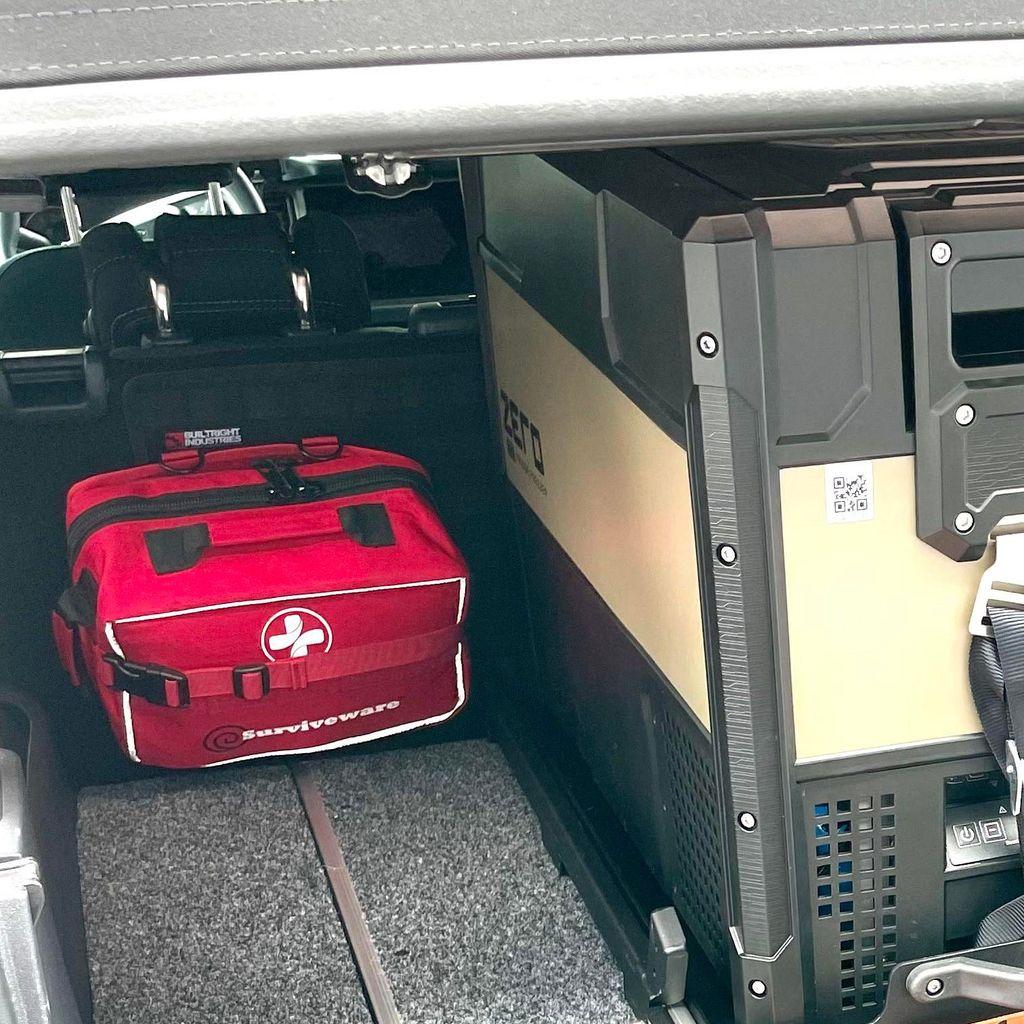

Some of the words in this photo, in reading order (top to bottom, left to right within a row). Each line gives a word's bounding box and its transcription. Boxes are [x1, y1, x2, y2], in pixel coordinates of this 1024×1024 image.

[184, 427, 241, 439] BUILTRIGHT
[184, 435, 242, 447] INDUSTRIES
[241, 699, 401, 741] Surviveware
